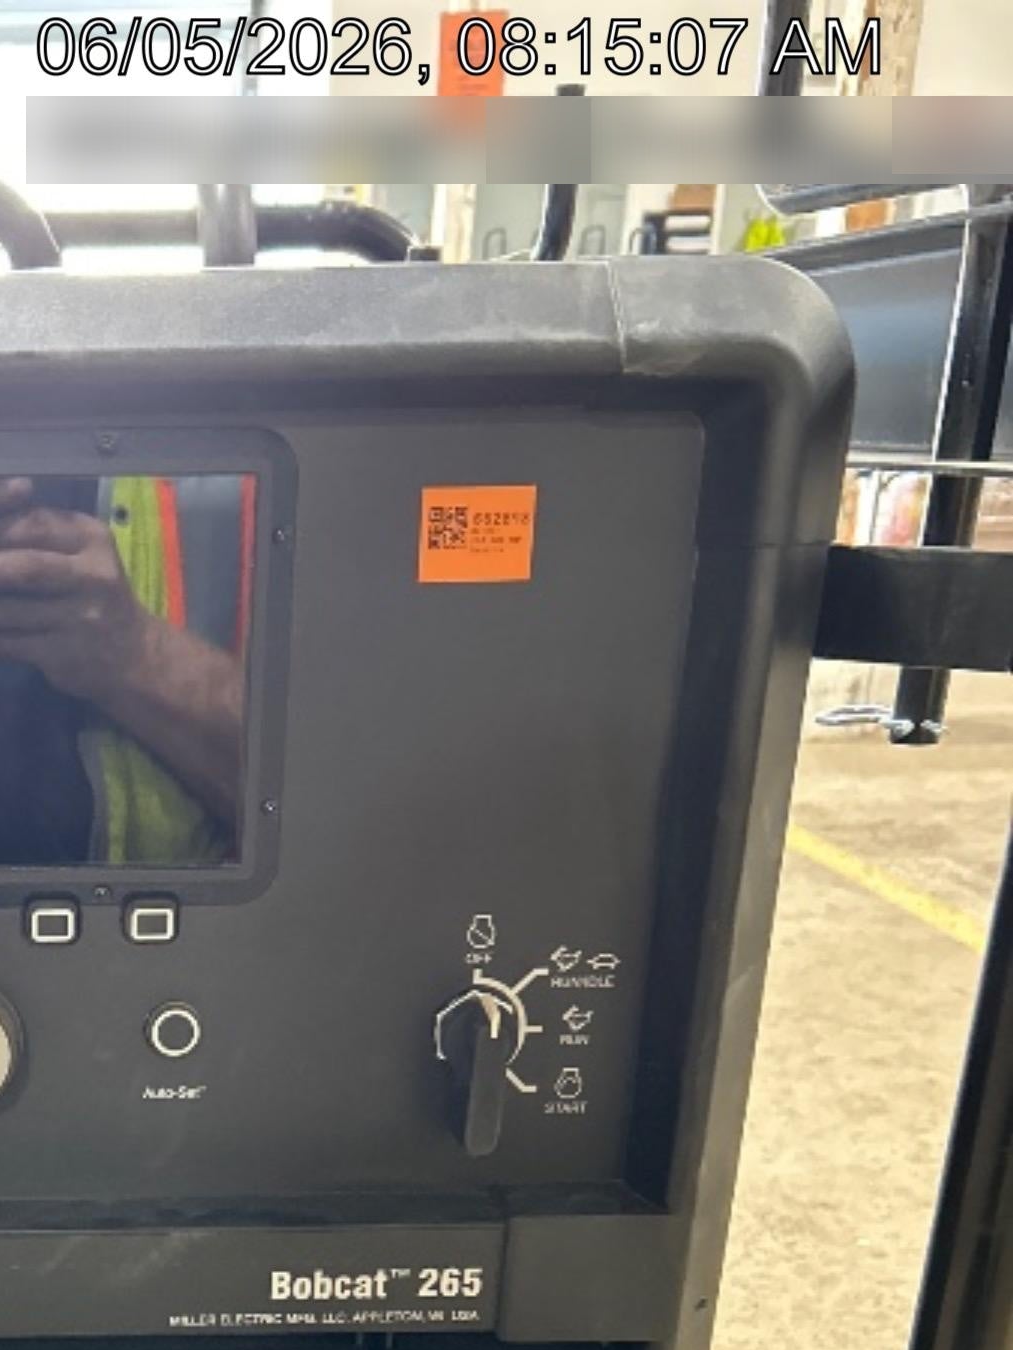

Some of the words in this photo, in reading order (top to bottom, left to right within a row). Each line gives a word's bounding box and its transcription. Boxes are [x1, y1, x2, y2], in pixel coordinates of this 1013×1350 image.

[417, 1267, 483, 1298] 265
[169, 1314, 216, 1327] MILLER
[220, 1313, 283, 1326] ELECTRIC
